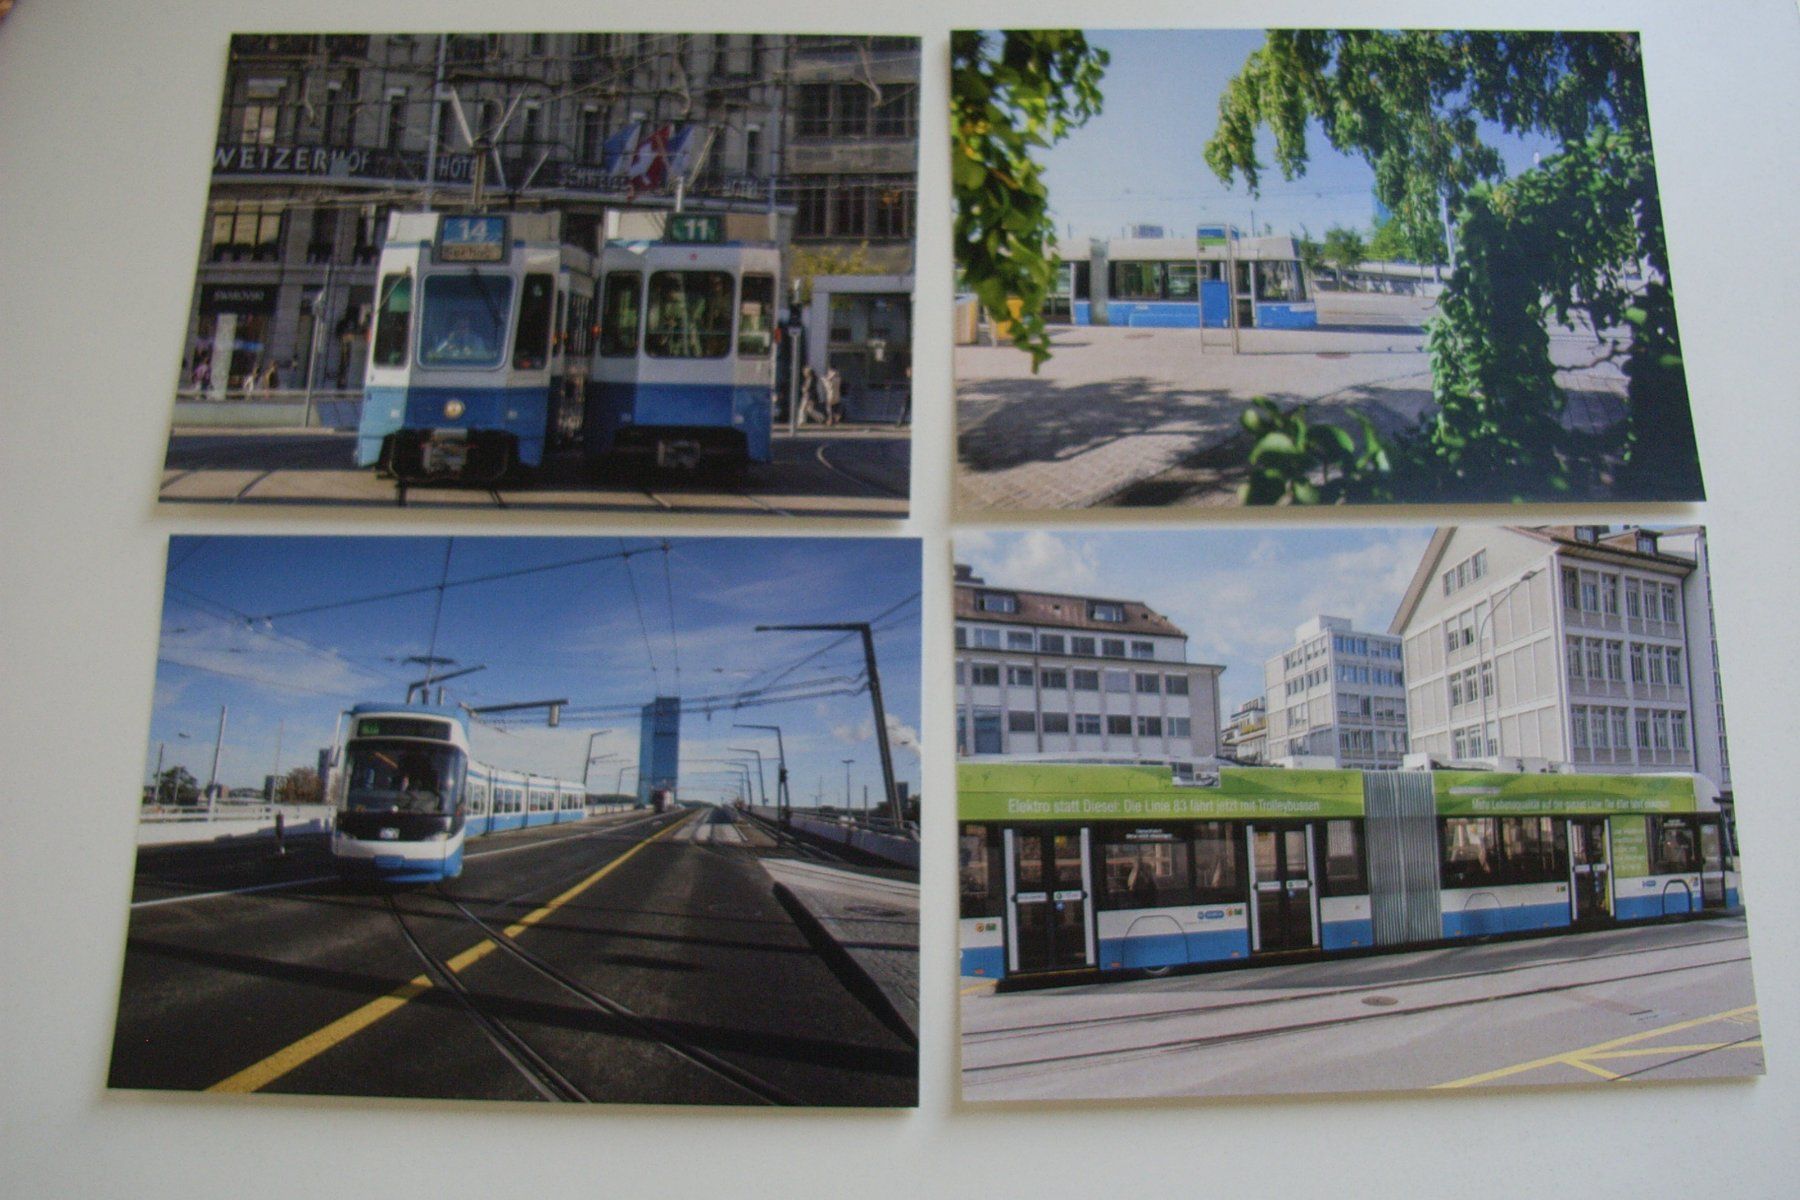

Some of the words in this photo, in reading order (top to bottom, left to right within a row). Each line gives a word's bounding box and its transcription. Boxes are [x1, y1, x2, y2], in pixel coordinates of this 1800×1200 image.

[459, 219, 488, 241] 14
[684, 219, 708, 240] 11
[1008, 798, 1050, 813] Elektro
[1054, 798, 1080, 813] statt
[1124, 798, 1142, 813] Die
[1145, 798, 1171, 812] Linie
[1173, 798, 1188, 812] 83
